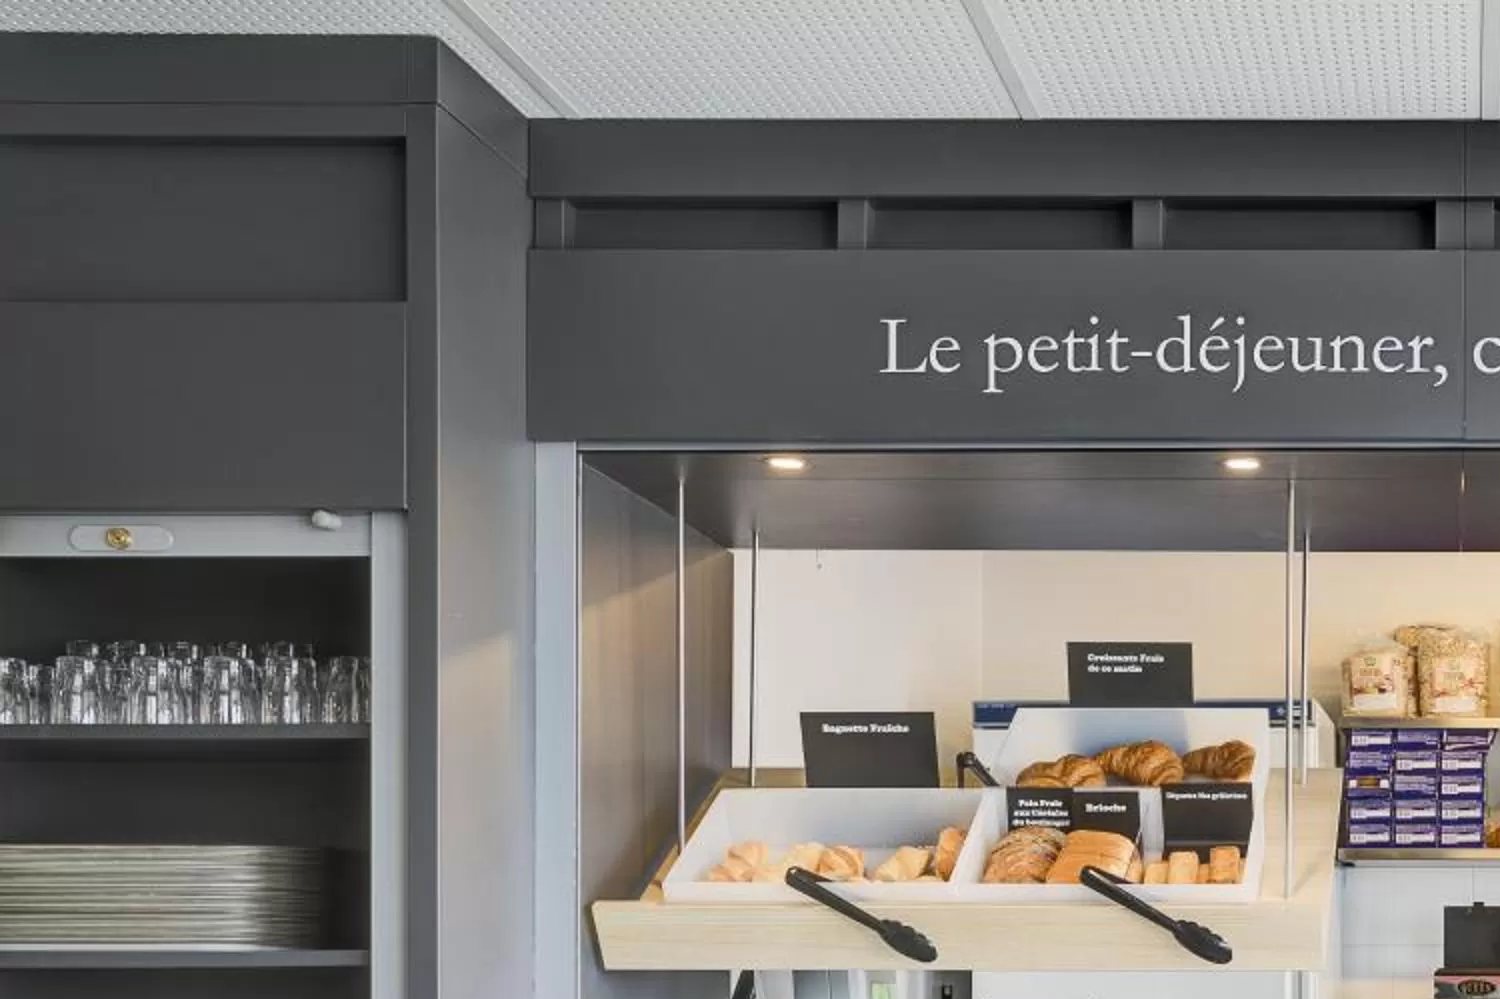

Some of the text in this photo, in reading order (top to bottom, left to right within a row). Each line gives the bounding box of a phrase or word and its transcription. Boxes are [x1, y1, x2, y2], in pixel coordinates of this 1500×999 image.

[879, 318, 961, 374] Le
[983, 313, 1448, 394] petit-déjeuner,
[1085, 803, 1127, 813] Brioche
